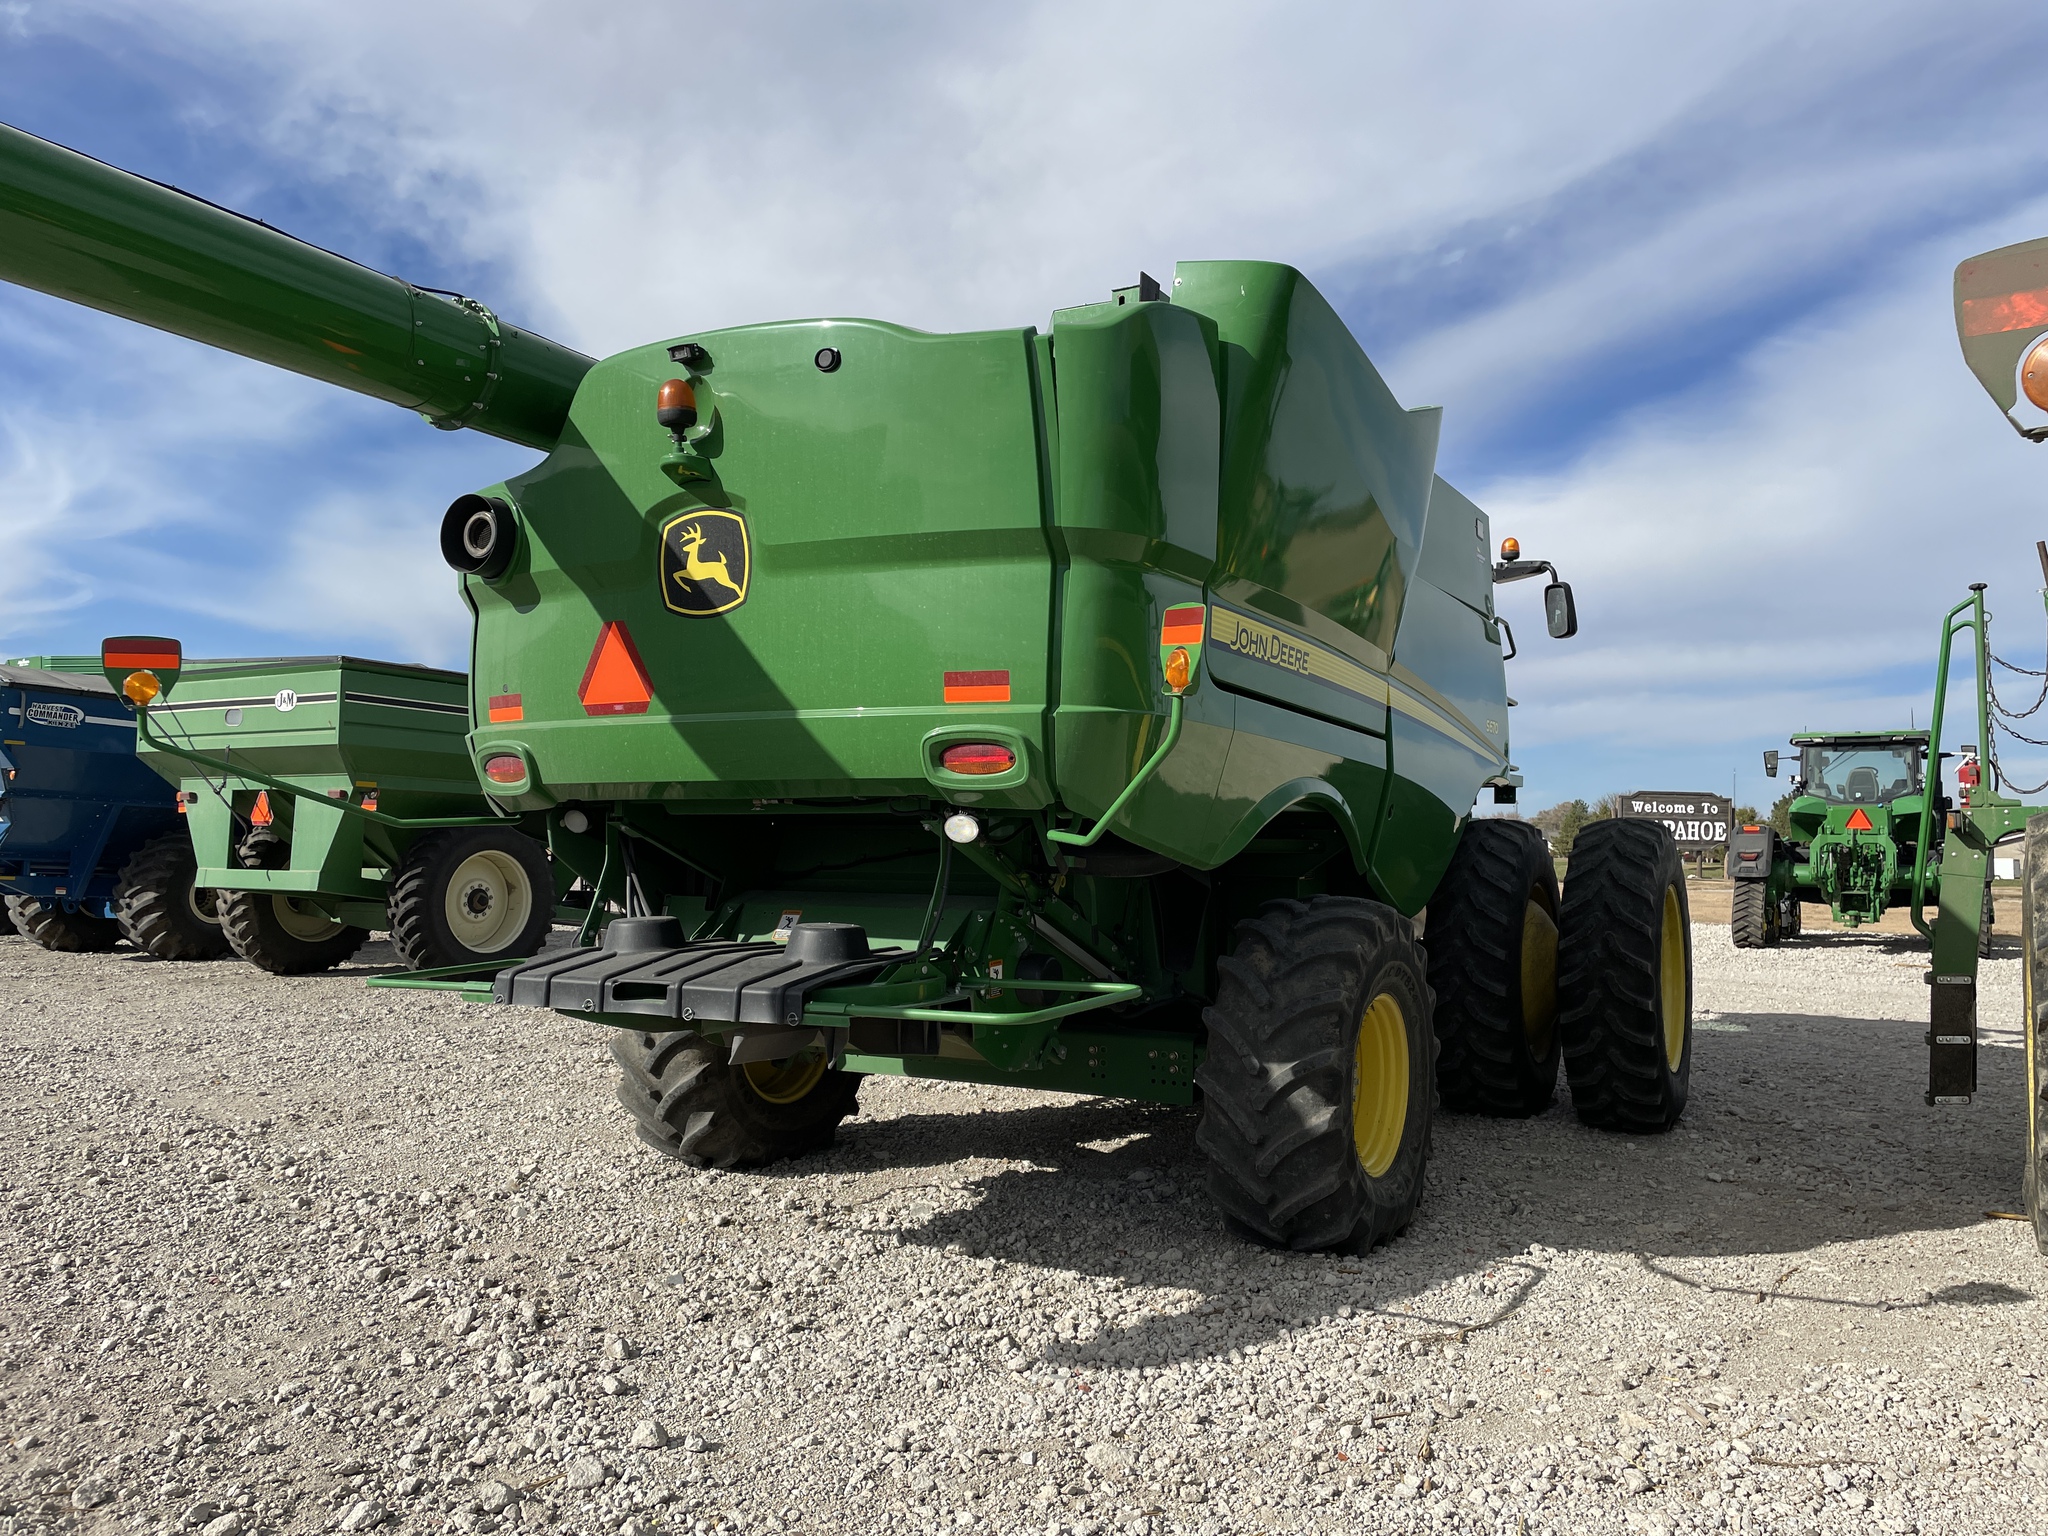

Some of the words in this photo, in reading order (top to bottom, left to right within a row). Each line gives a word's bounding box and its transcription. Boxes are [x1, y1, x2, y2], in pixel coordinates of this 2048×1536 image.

[1230, 621, 1268, 658] JOHN
[1270, 634, 1310, 672] DEERE
[32, 702, 64, 712] HARVEST
[277, 692, 294, 708] J&M
[27, 708, 79, 724] COMMANDER
[1631, 801, 1695, 814] Welcome
[1701, 802, 1719, 814] To
[1654, 820, 1727, 841] PAHOE
